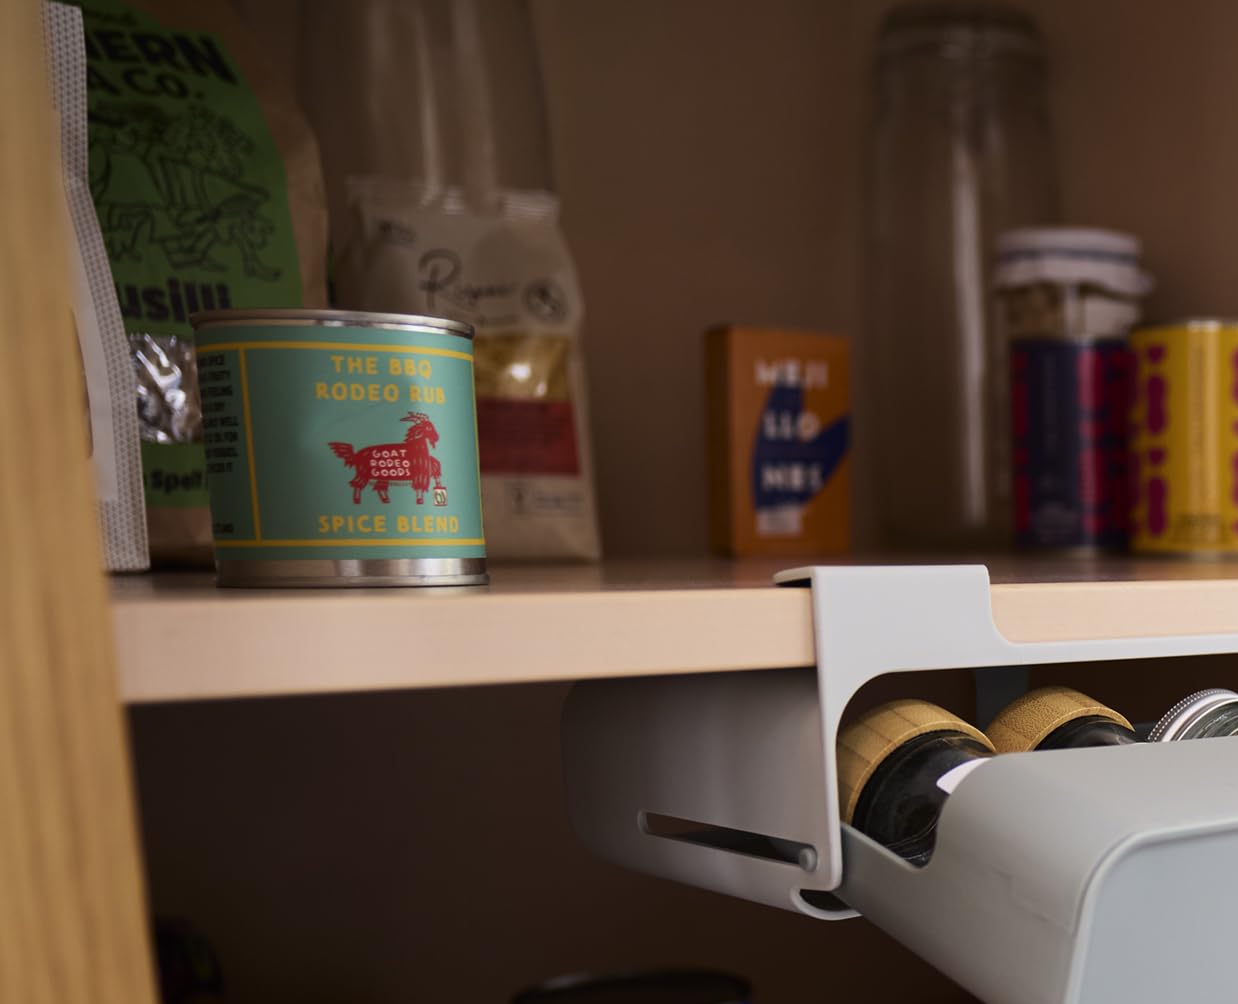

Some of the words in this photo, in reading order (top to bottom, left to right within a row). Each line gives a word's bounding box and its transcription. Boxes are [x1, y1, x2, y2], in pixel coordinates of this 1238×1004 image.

[330, 354, 378, 375] THE
[389, 357, 433, 380] BBQ
[315, 382, 400, 403] RODEO
[409, 385, 446, 405] RUB
[372, 449, 408, 459] GOAT
[369, 459, 411, 468] RODEO
[371, 467, 411, 478] GOODS
[319, 514, 387, 534] SPICE
[397, 514, 460, 534] BLEND
